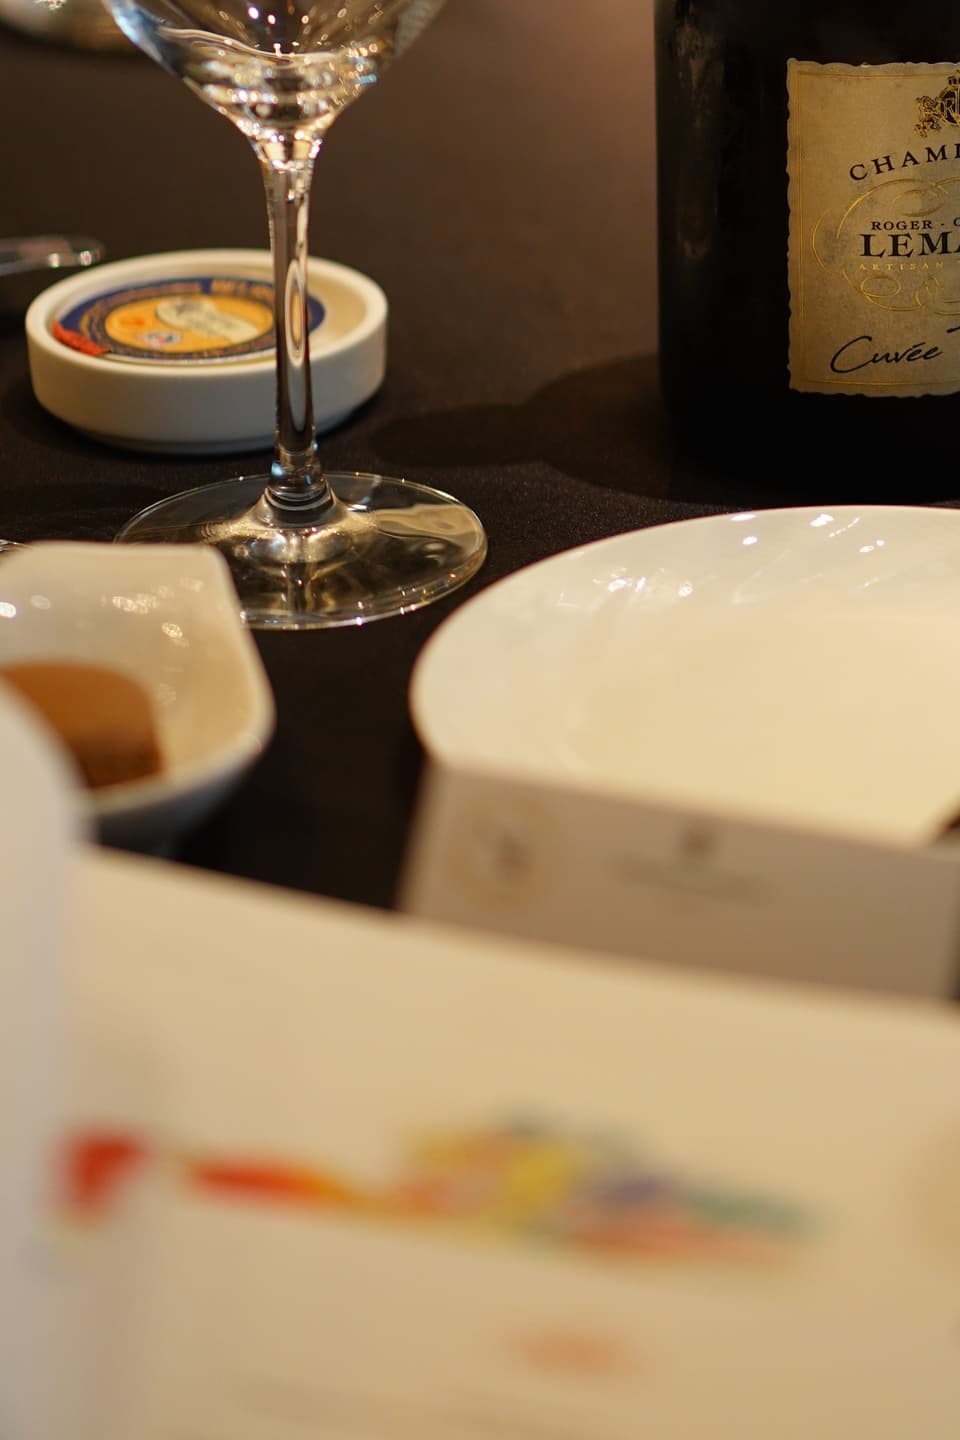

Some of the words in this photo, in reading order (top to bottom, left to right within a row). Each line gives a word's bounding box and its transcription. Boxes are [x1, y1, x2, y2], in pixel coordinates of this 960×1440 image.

[871, 220, 933, 231] ROGER
[859, 261, 944, 271] ARTISAN
[829, 335, 945, 374] Cuvée
